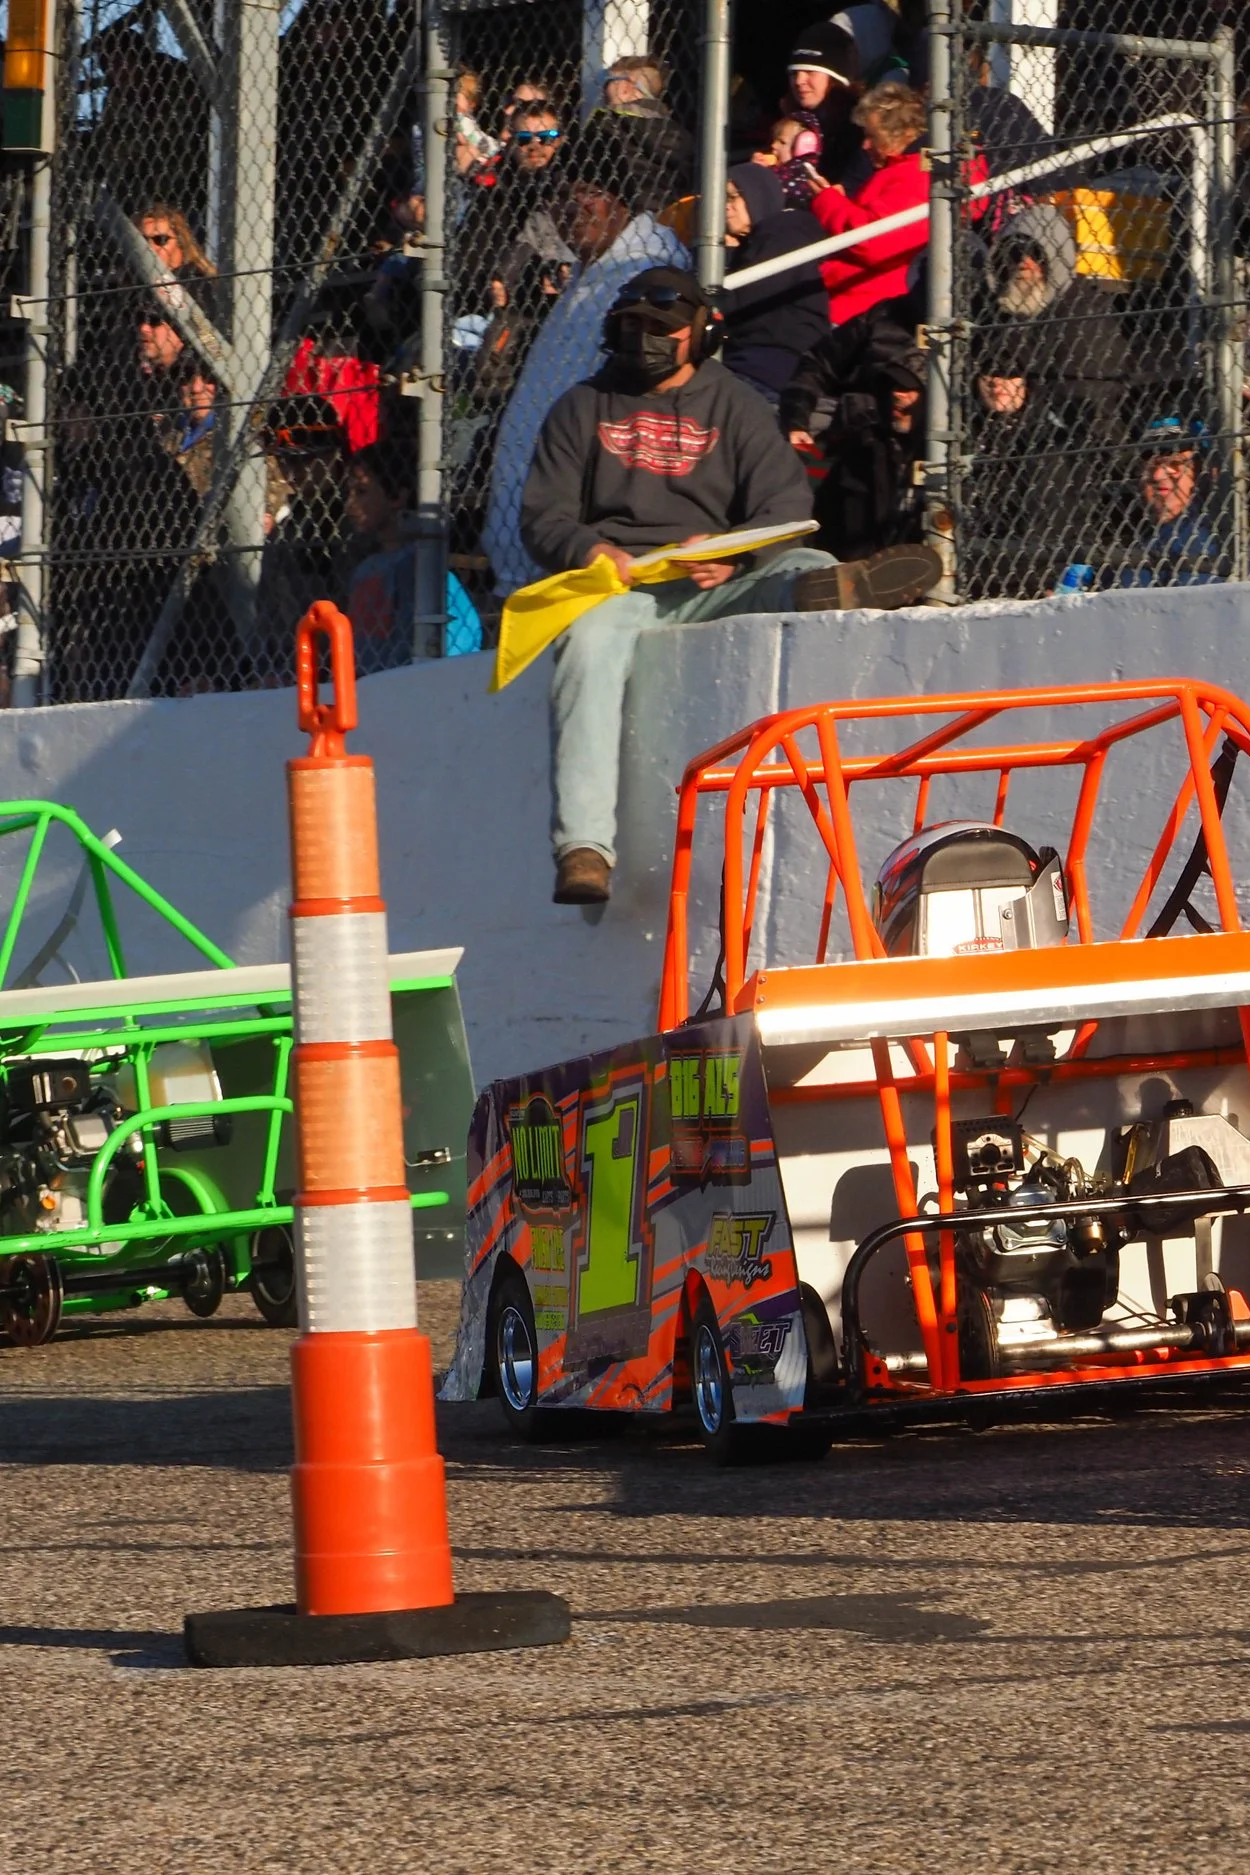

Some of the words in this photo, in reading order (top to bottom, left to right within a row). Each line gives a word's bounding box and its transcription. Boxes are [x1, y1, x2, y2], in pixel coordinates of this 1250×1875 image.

[670, 1056, 701, 1119] BIG
[512, 1125, 529, 1186] NO
[529, 1125, 561, 1186] LIMIT
[708, 1215, 772, 1259] FAST
